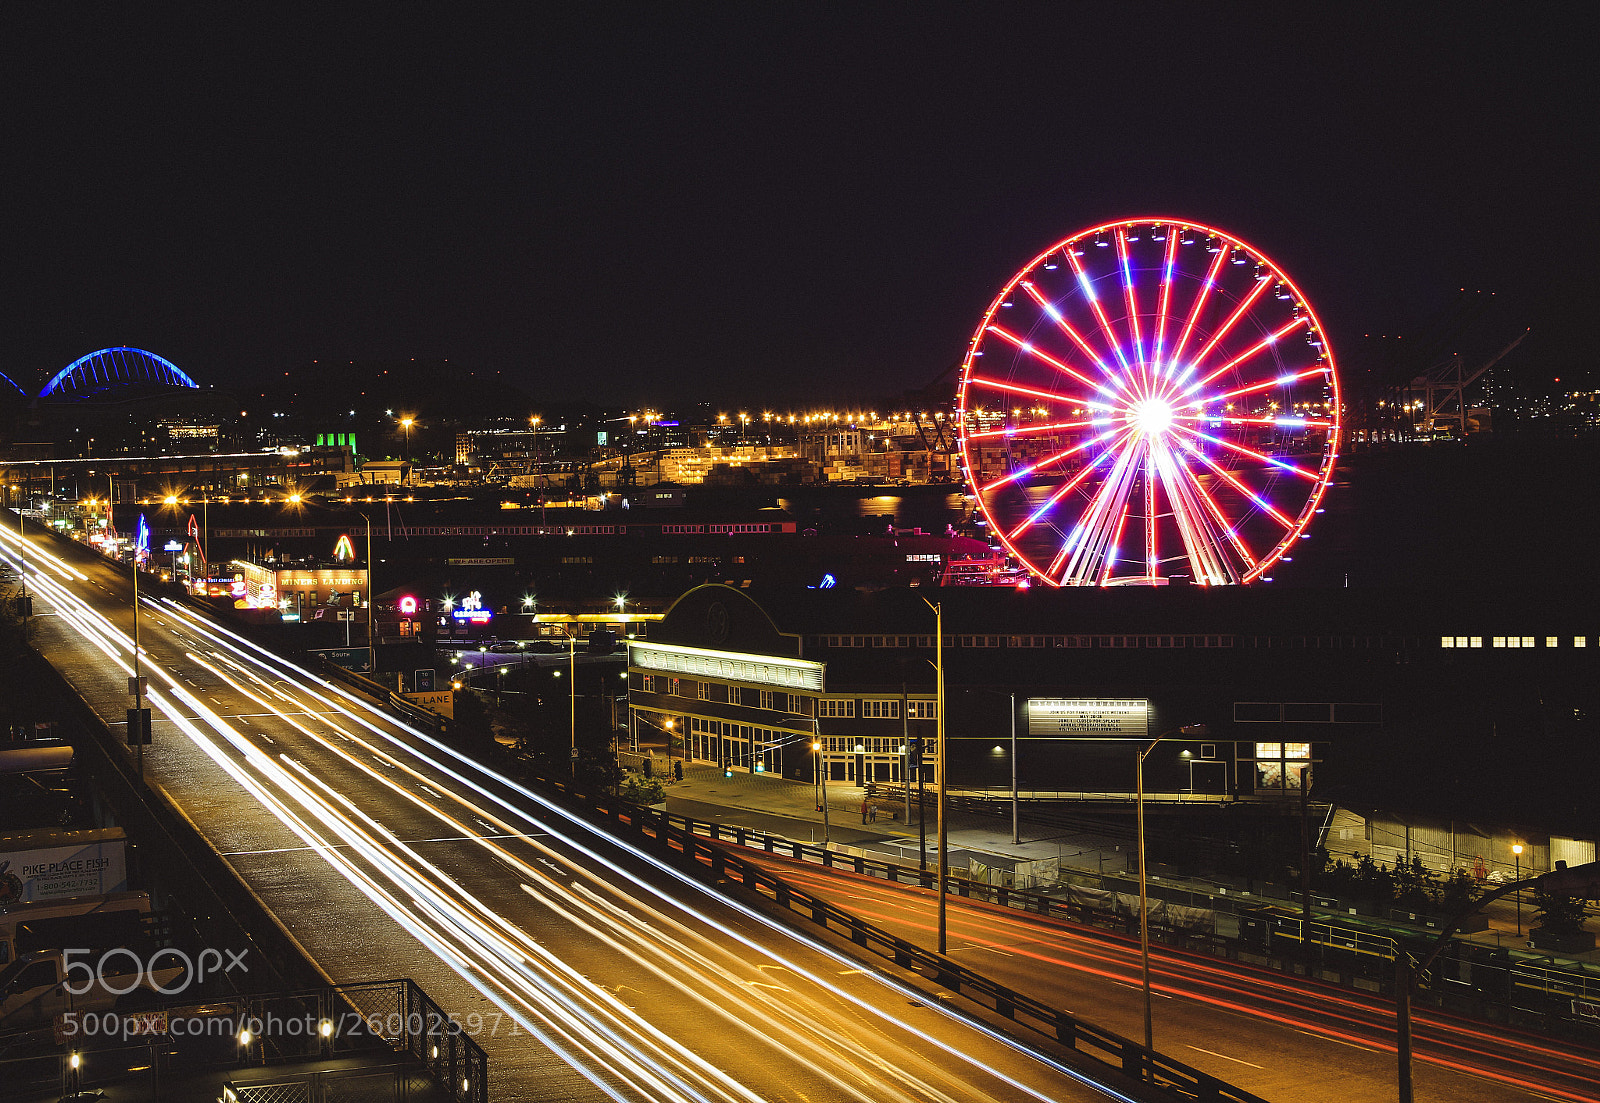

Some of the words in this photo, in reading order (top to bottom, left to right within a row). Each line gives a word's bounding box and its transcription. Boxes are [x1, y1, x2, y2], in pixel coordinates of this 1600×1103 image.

[281, 578, 318, 586] MINERS
[322, 578, 363, 586] LANDING
[643, 651, 710, 673] SEATTLE
[717, 660, 805, 686] AQUARIUM
[423, 695, 450, 704] LANE
[22, 864, 46, 875] PIKE
[49, 860, 83, 873] PLACE
[86, 857, 109, 869] FISH
